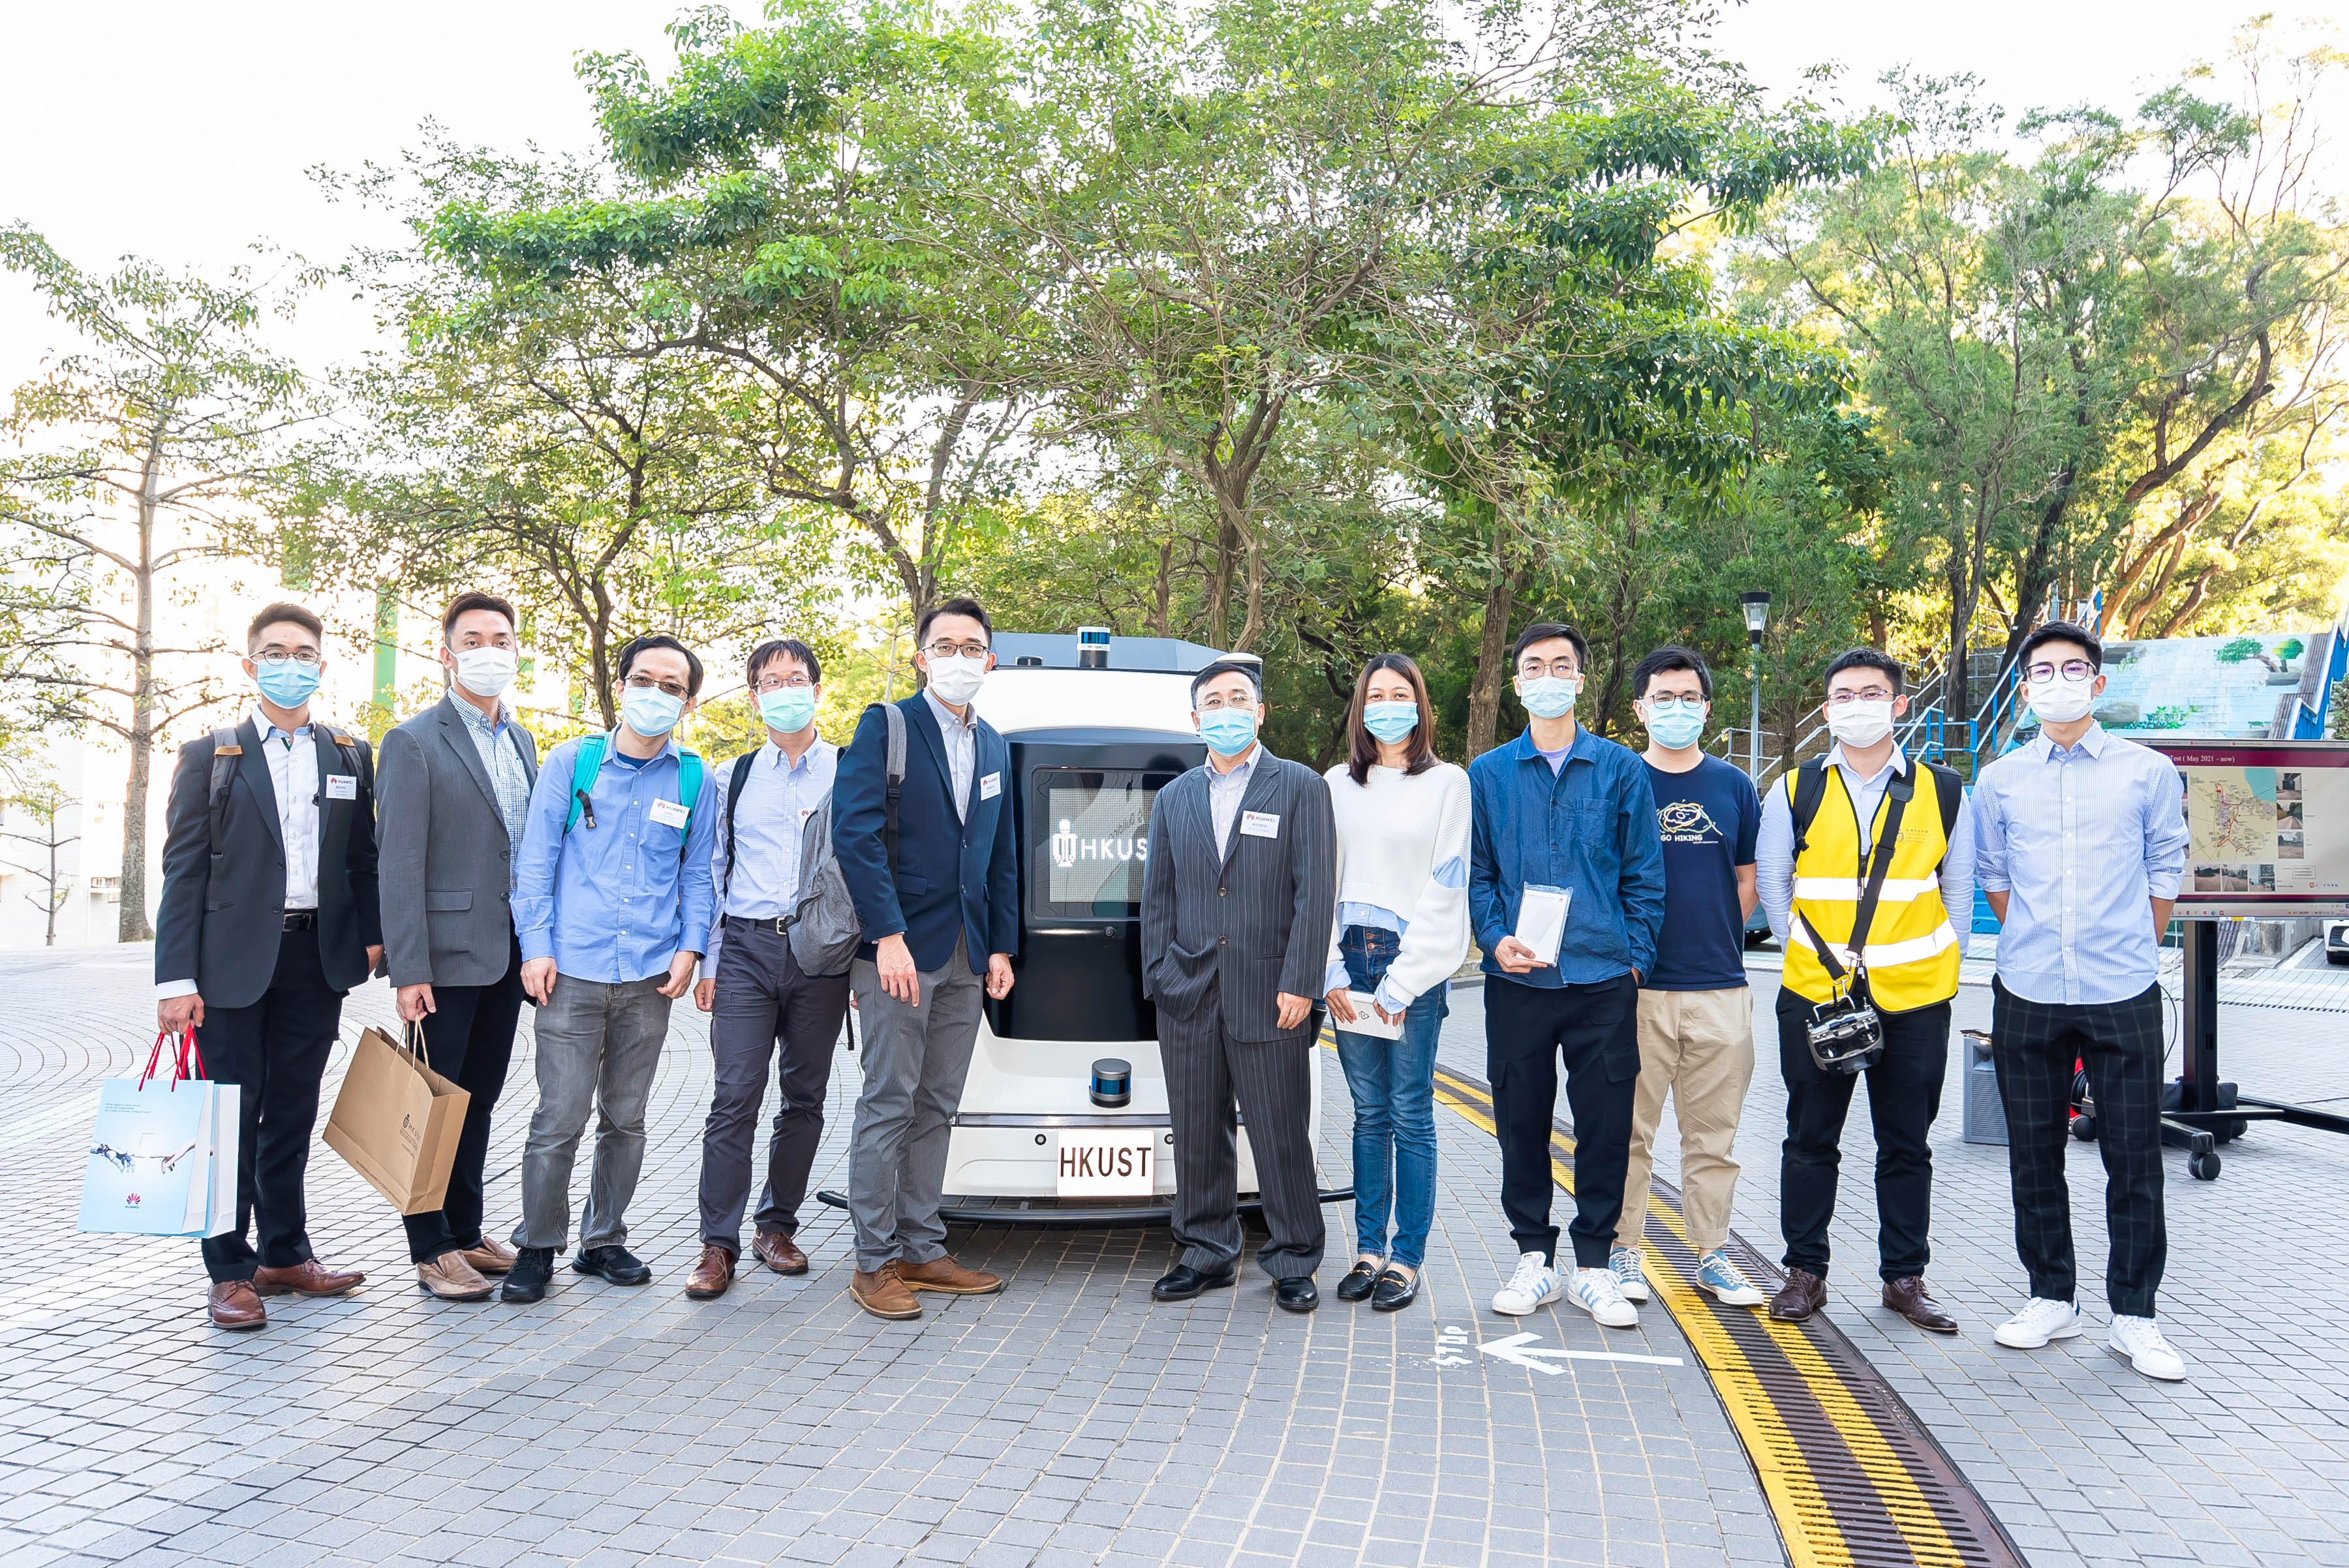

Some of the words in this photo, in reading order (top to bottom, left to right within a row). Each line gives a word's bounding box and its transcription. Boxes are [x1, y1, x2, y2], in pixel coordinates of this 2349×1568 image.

[666, 805, 685, 814] HUAWEI
[1081, 837, 1147, 861] HKUS
[1060, 1147, 1152, 1177] HKUST
